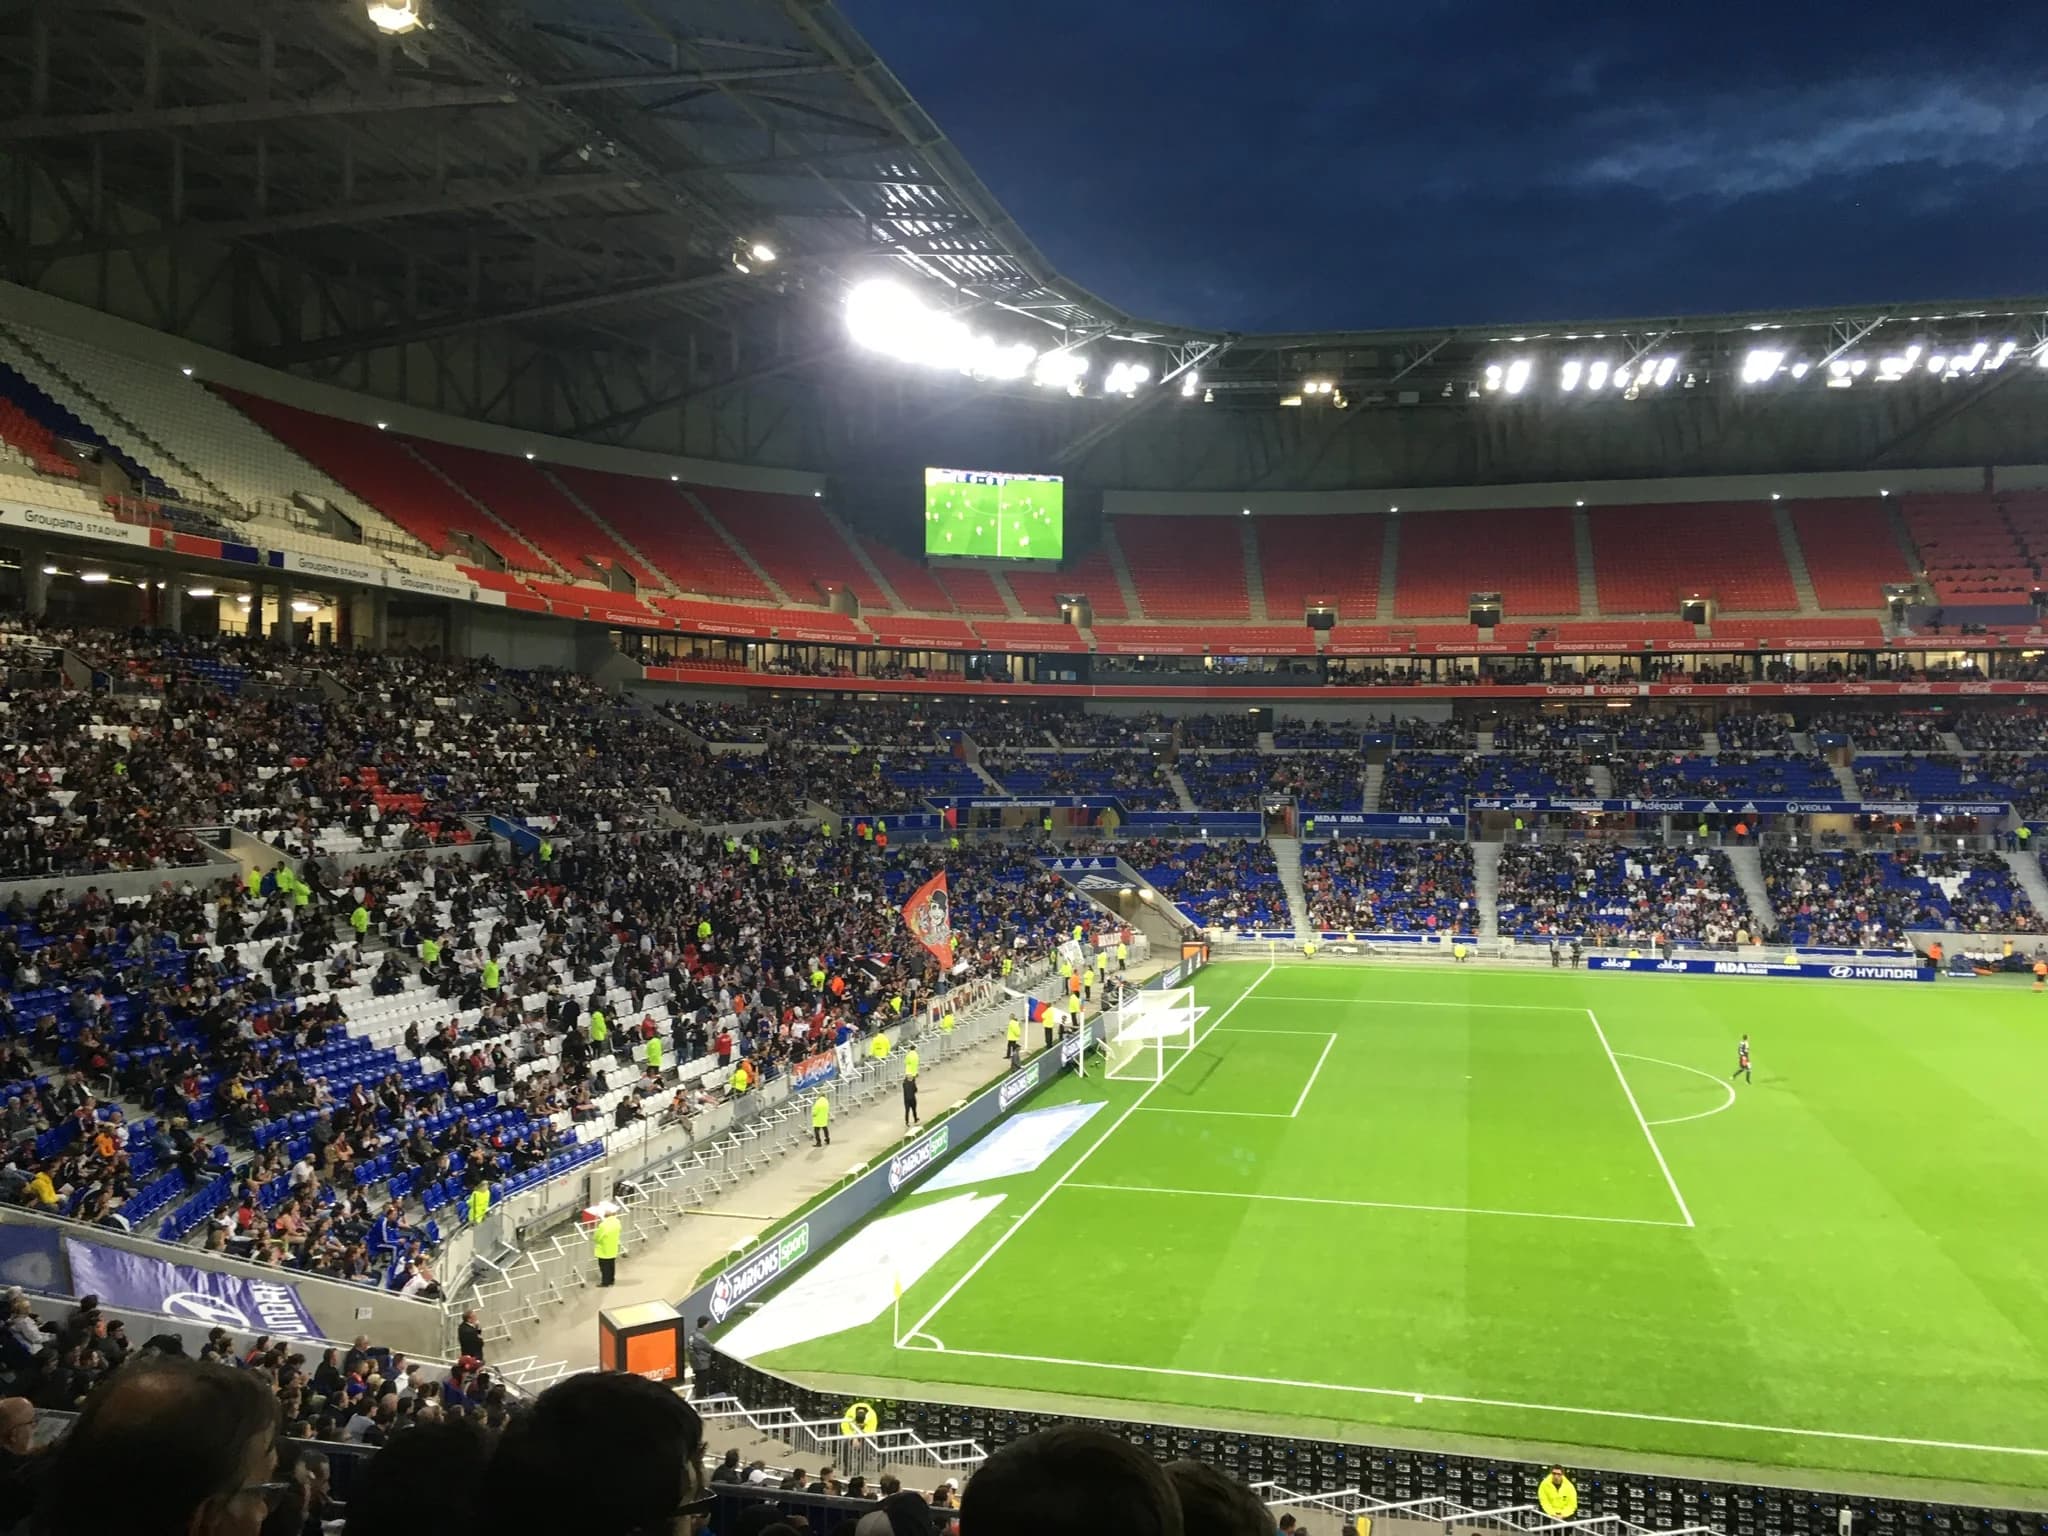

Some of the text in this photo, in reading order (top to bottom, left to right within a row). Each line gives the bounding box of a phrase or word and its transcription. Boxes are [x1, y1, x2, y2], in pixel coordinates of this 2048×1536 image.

[24, 510, 128, 538] Groupama STADIUM
[299, 558, 368, 578] Groupama STADIUM
[401, 576, 460, 594] Groupama STADIUM
[1668, 641, 1710, 650] Groupama
[1785, 639, 1829, 648] Groupama
[1546, 686, 1582, 695] Orange
[1600, 685, 1637, 694] Orange
[1641, 801, 1683, 811] Adéquat
[1341, 815, 1364, 823] MDA
[1426, 816, 1449, 824] MDA
[1714, 962, 1746, 974] MDA
[1856, 966, 1917, 979] HYUNDAI
[902, 1143, 929, 1177] PARIONS
[733, 1228, 807, 1299] PARIONS sport
